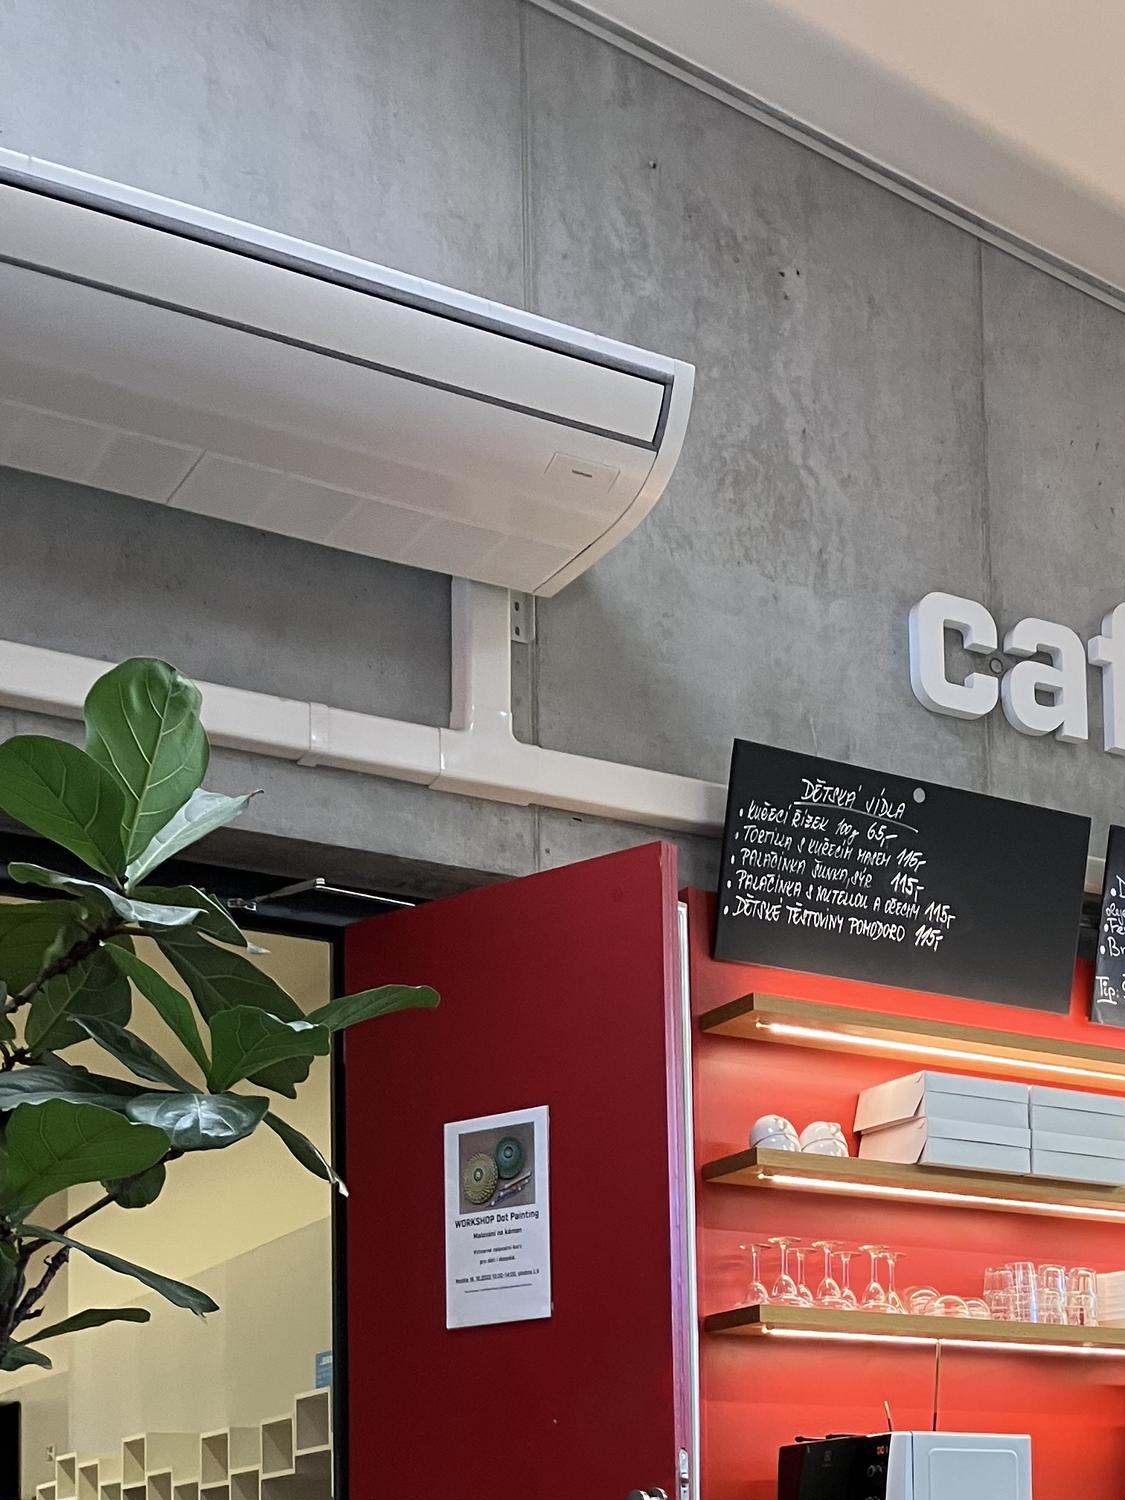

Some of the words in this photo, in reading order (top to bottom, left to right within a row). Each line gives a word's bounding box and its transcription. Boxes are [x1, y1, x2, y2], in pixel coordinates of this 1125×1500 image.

[740, 847, 807, 876] PALAČINKA
[744, 825, 793, 851] TORTILLA
[857, 848, 891, 867] MASEM
[735, 869, 802, 898] PALAČINKA
[815, 885, 869, 909] NUTELLOU
[873, 897, 881, 911] A
[732, 893, 783, 922] DĚTSKÉ
[785, 901, 845, 935] TĚSTOVINY
[848, 917, 906, 943] POMODORO
[455, 1214, 495, 1229] WORKSHOP
[496, 1212, 510, 1223] Dot
[510, 1209, 540, 1222] Painting
